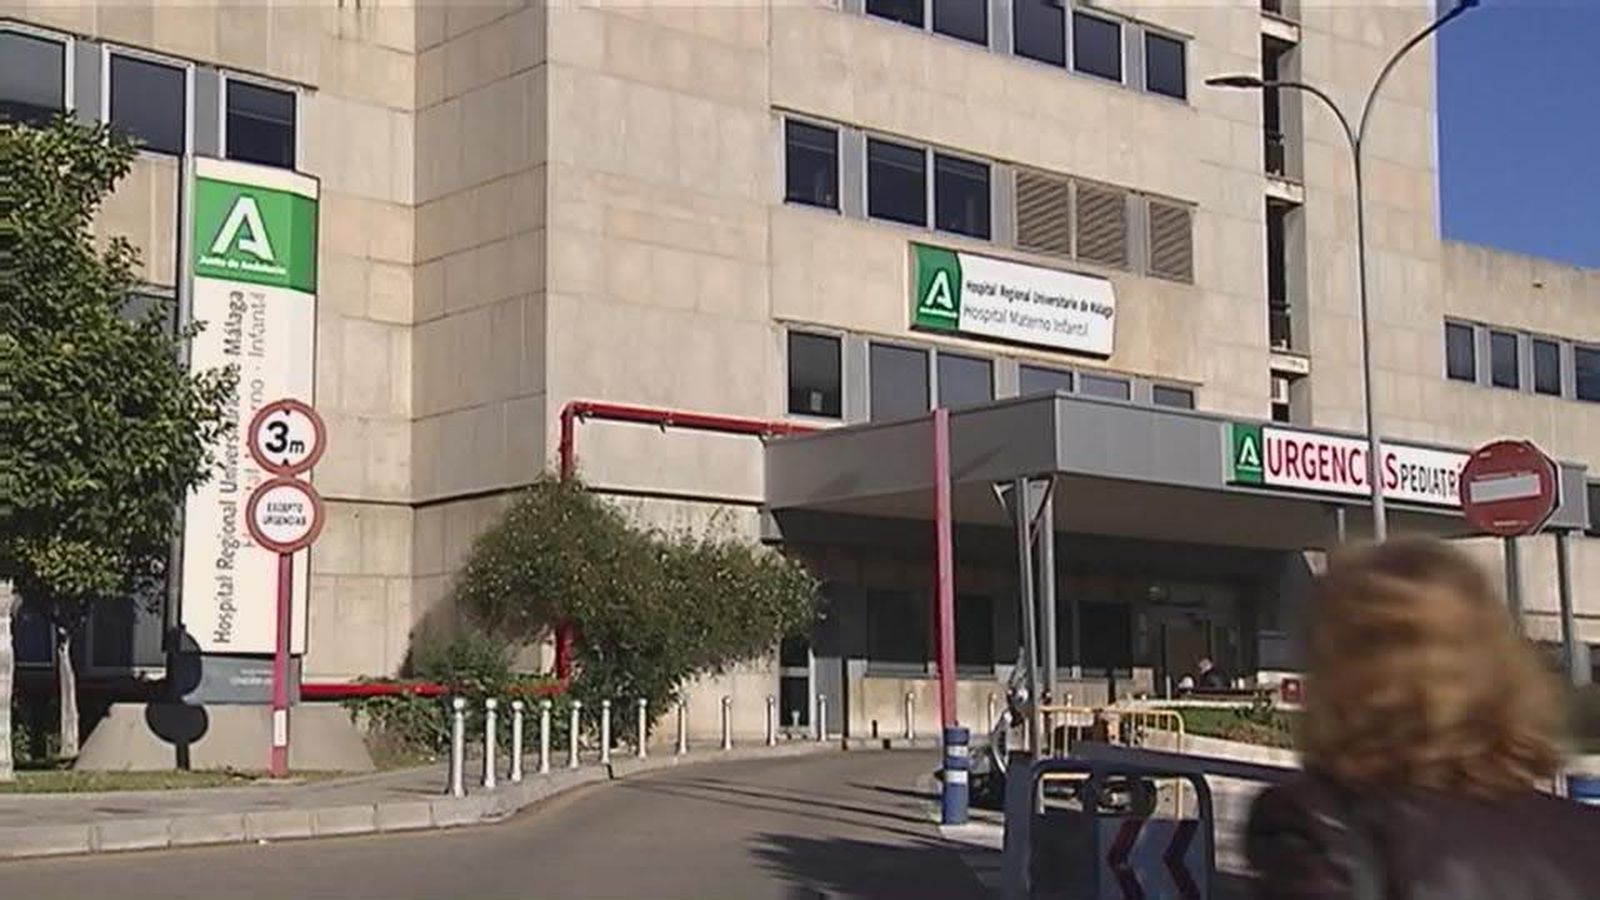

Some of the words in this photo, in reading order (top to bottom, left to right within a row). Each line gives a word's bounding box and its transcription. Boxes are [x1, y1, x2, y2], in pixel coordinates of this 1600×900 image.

[223, 290, 247, 356] Málaga
[963, 304, 1008, 324] Hospital
[1009, 310, 1051, 331] Materno
[966, 281, 998, 297] Hospital
[1000, 284, 1031, 303] Regional
[215, 500, 241, 570] Regional
[212, 575, 236, 644] Hospital
